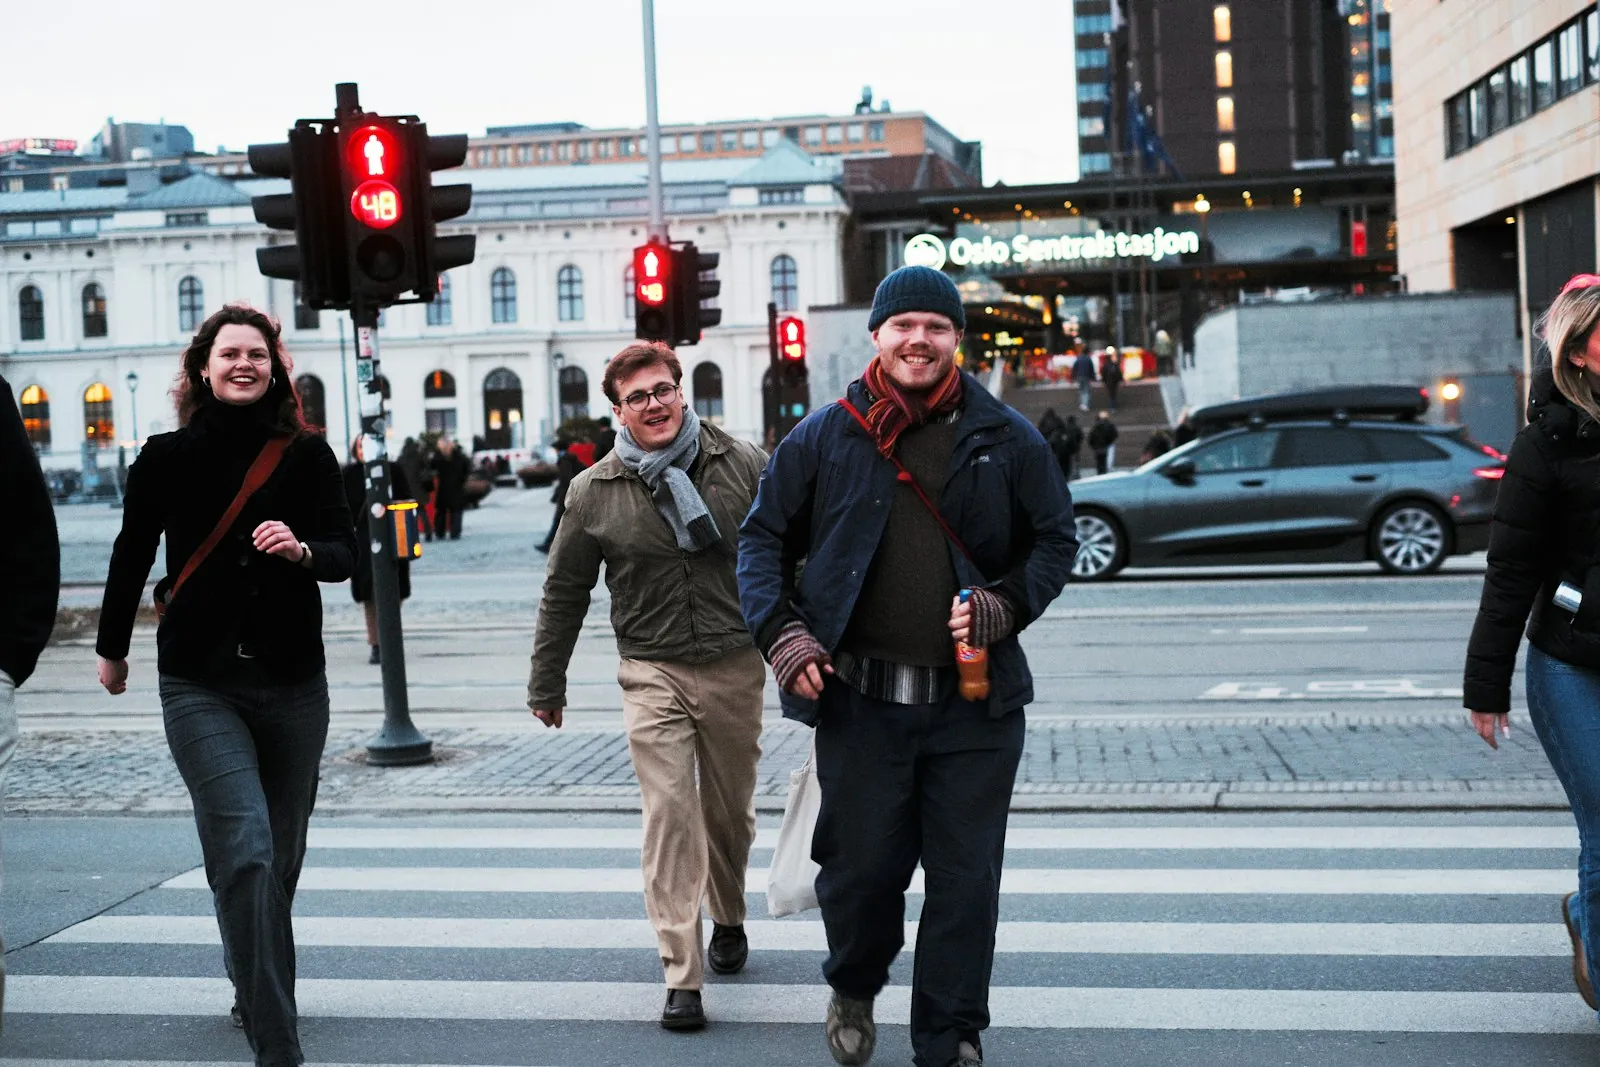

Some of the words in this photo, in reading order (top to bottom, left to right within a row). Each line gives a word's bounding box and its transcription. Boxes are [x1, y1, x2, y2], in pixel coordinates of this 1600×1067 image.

[361, 190, 397, 220] 48
[950, 235, 1009, 265] Oslo
[1012, 227, 1199, 263] Sentralstasjon
